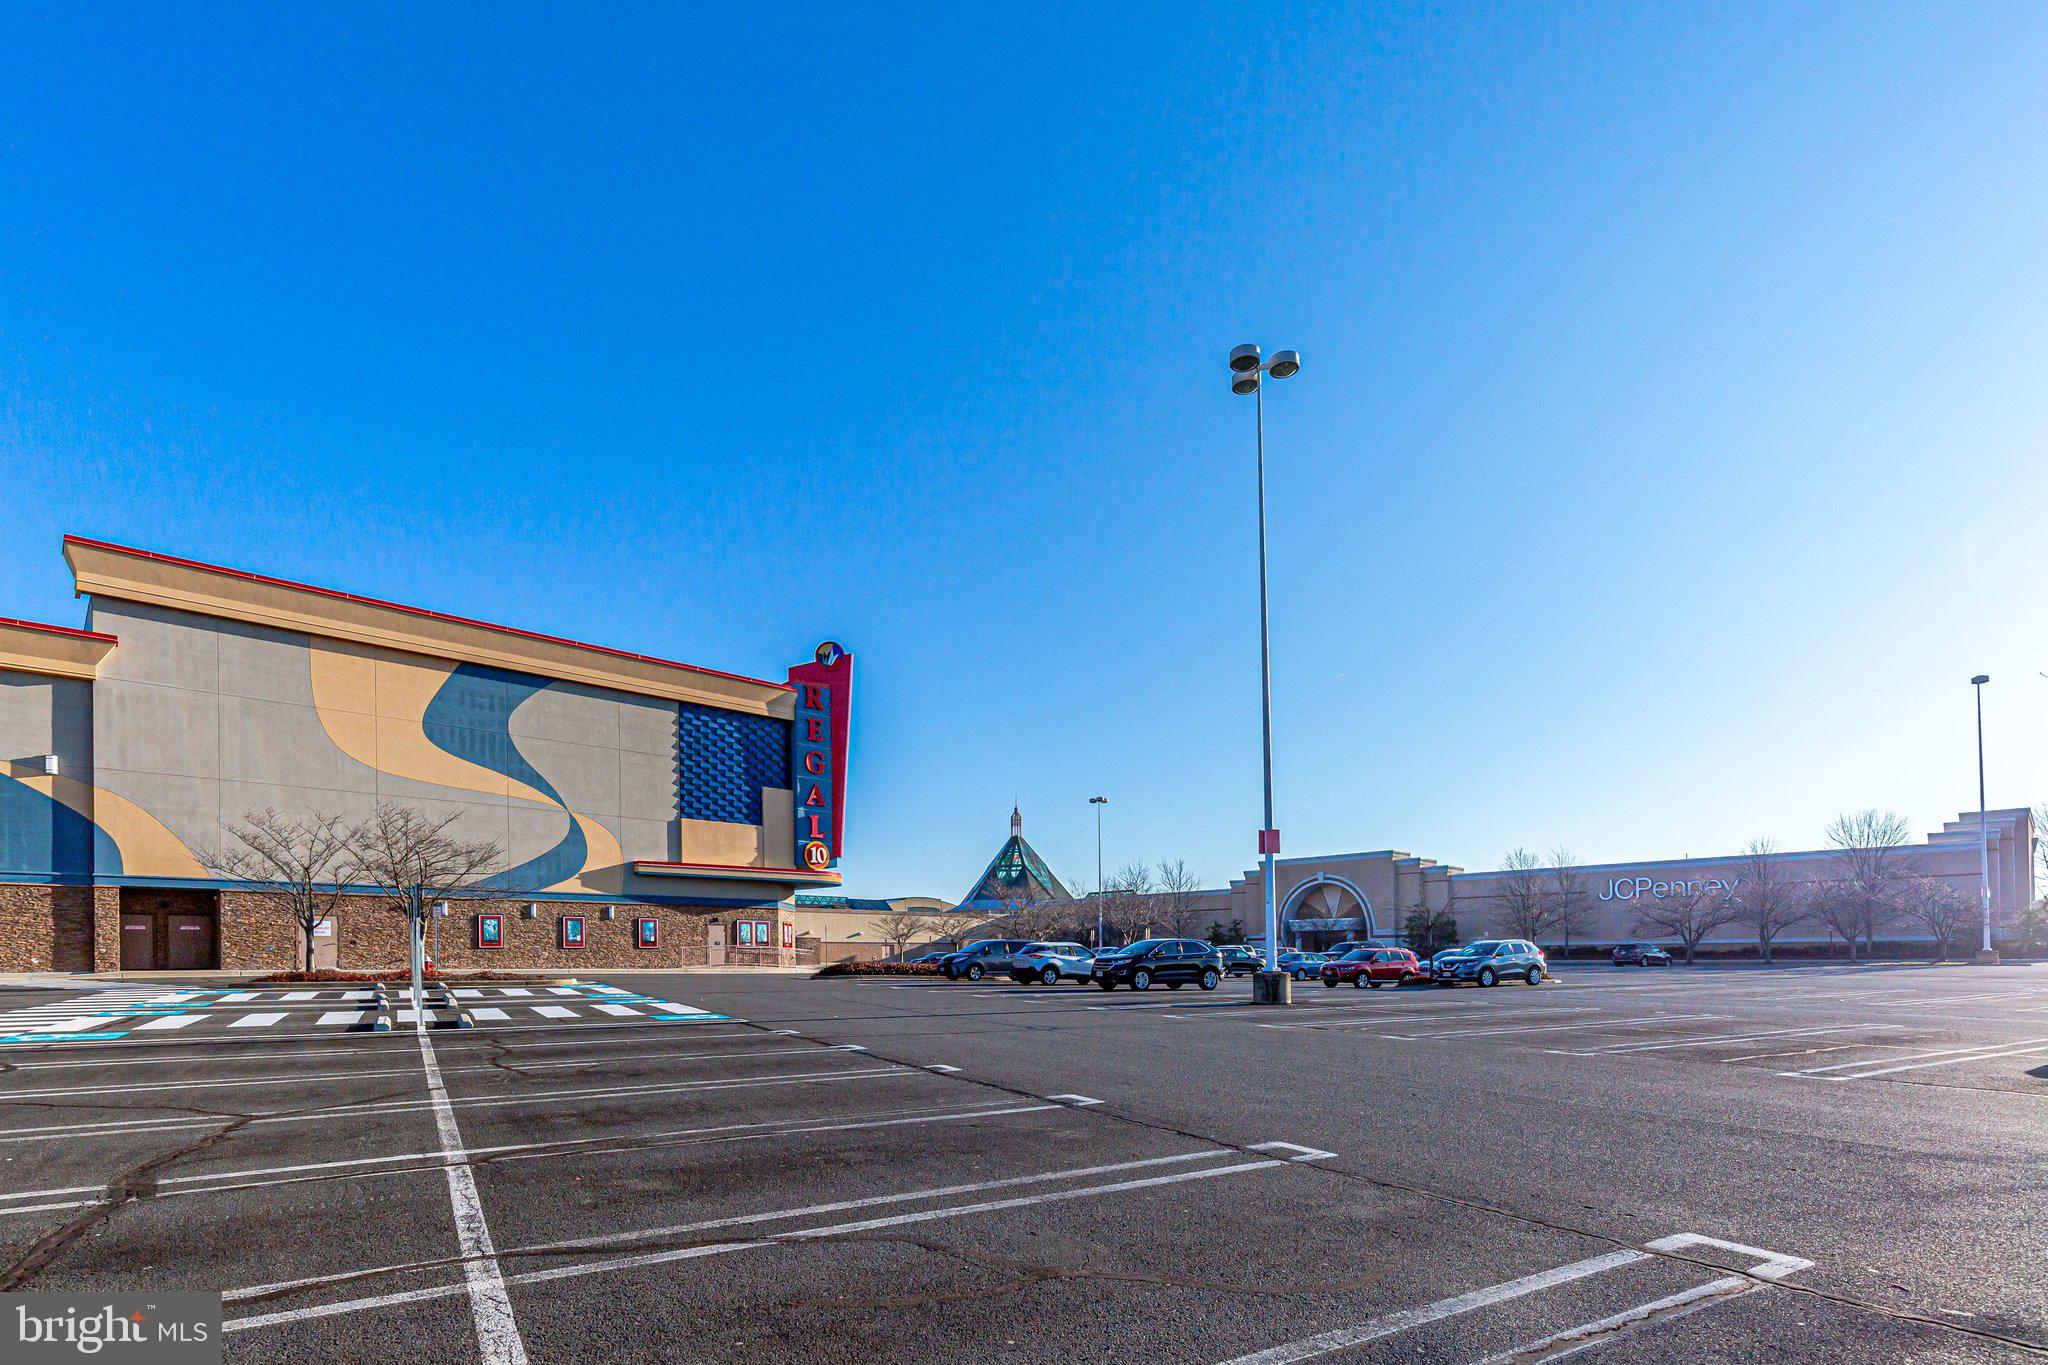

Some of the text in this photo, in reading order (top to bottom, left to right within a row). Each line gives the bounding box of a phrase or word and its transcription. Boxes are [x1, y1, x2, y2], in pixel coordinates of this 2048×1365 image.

[805, 686, 826, 839] REGAL
[810, 847, 827, 864] 10
[1599, 877, 1740, 901] JCPenney
